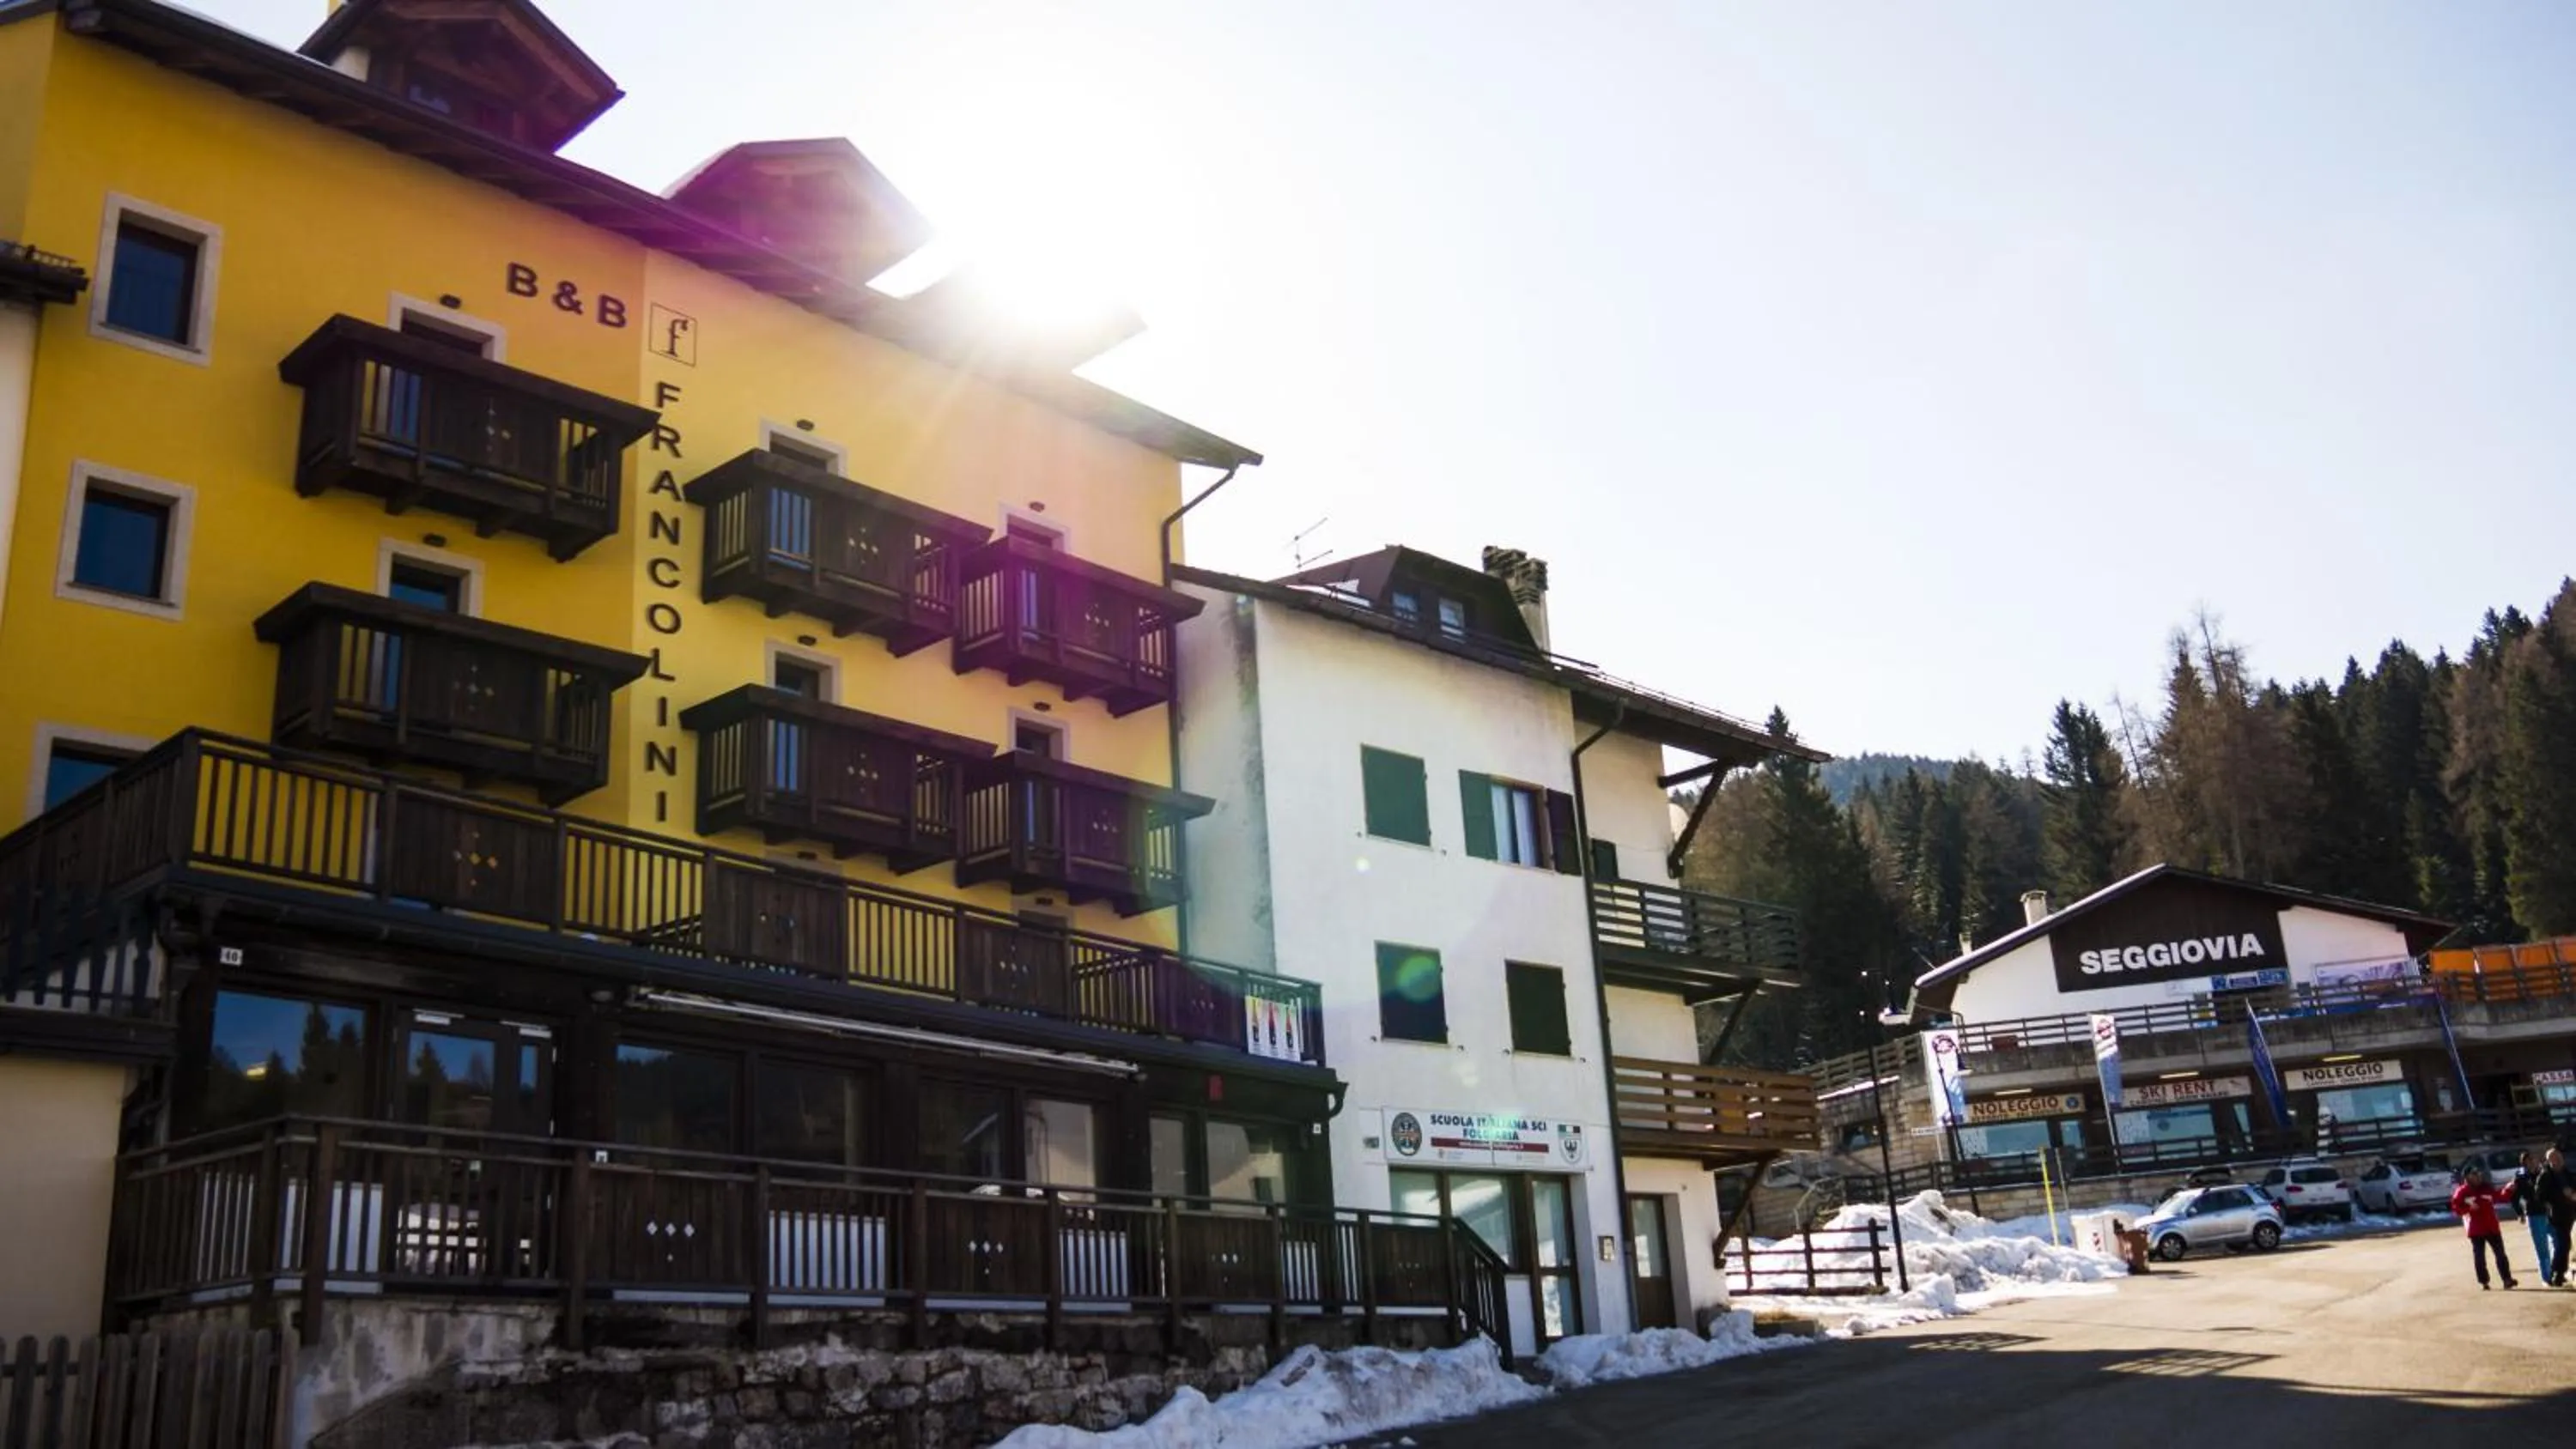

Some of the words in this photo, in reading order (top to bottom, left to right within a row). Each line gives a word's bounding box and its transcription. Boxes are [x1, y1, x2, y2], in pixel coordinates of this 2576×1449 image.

[646, 381, 682, 822] FRANCOLINI
[2079, 933, 2264, 974] SEGGIOVIA
[2302, 1063, 2384, 1081] NOLEGGIO
[2138, 1083, 2166, 1100] SKI
[2172, 1078, 2215, 1095] RENT
[1971, 1097, 2059, 1116] NOLEGGIO
[1430, 1114, 1474, 1127] SCUOLA
[1531, 1120, 1546, 1131] SCI
